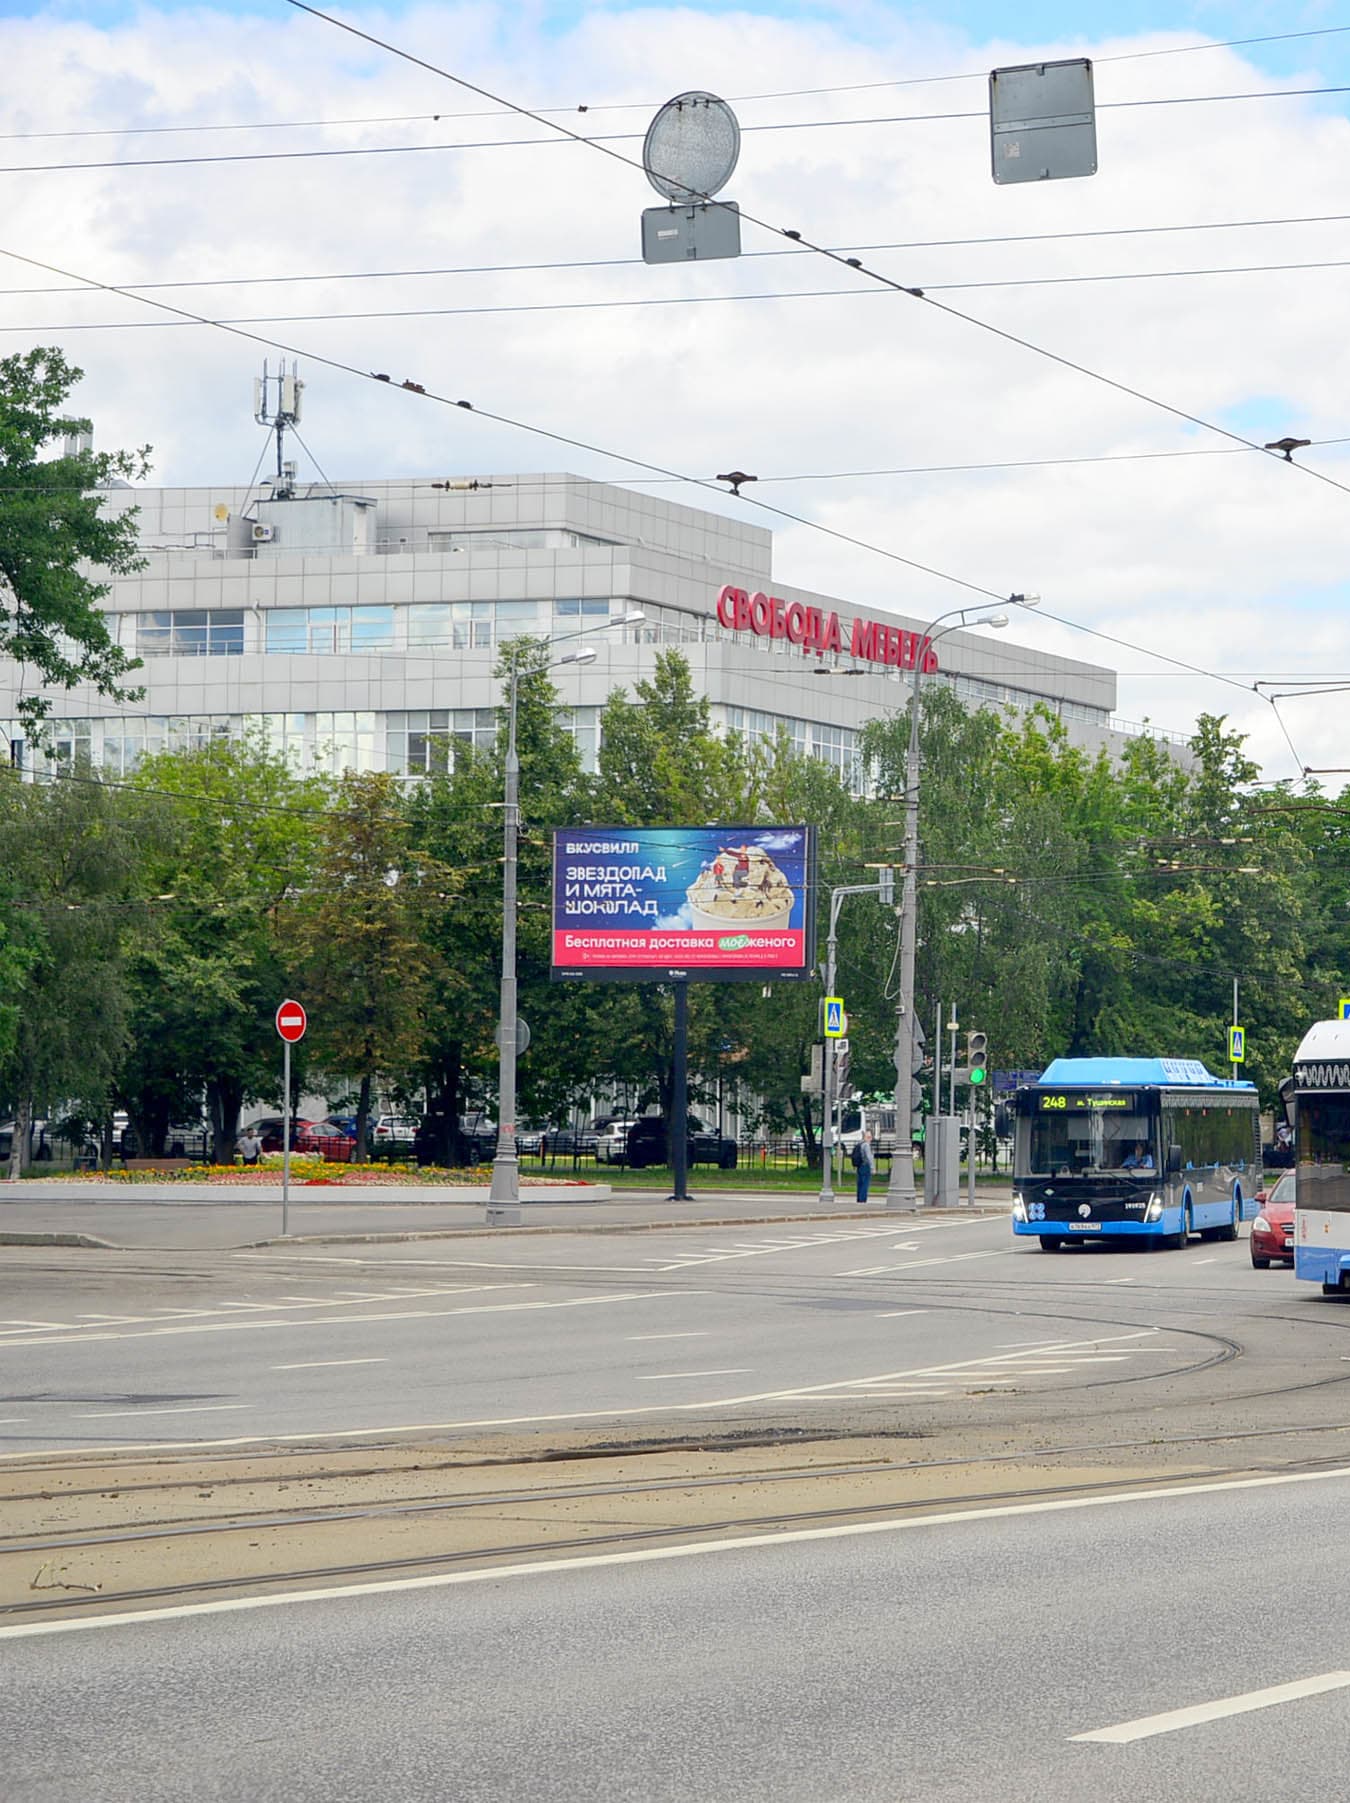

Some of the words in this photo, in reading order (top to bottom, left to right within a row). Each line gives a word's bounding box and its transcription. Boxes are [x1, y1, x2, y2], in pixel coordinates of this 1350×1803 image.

[717, 584, 842, 656] СВОБОДА
[565, 842, 639, 854] ВКУСВИЛЛ
[565, 866, 667, 882] ЗВЕЗДОПАД
[565, 883, 580, 897] И
[583, 883, 643, 897] МЯТА-
[565, 900, 658, 916] ШОКОЛАД
[565, 934, 646, 949] Бесплатная
[649, 938, 714, 949] доставка
[1042, 1096, 1066, 1108] 248
